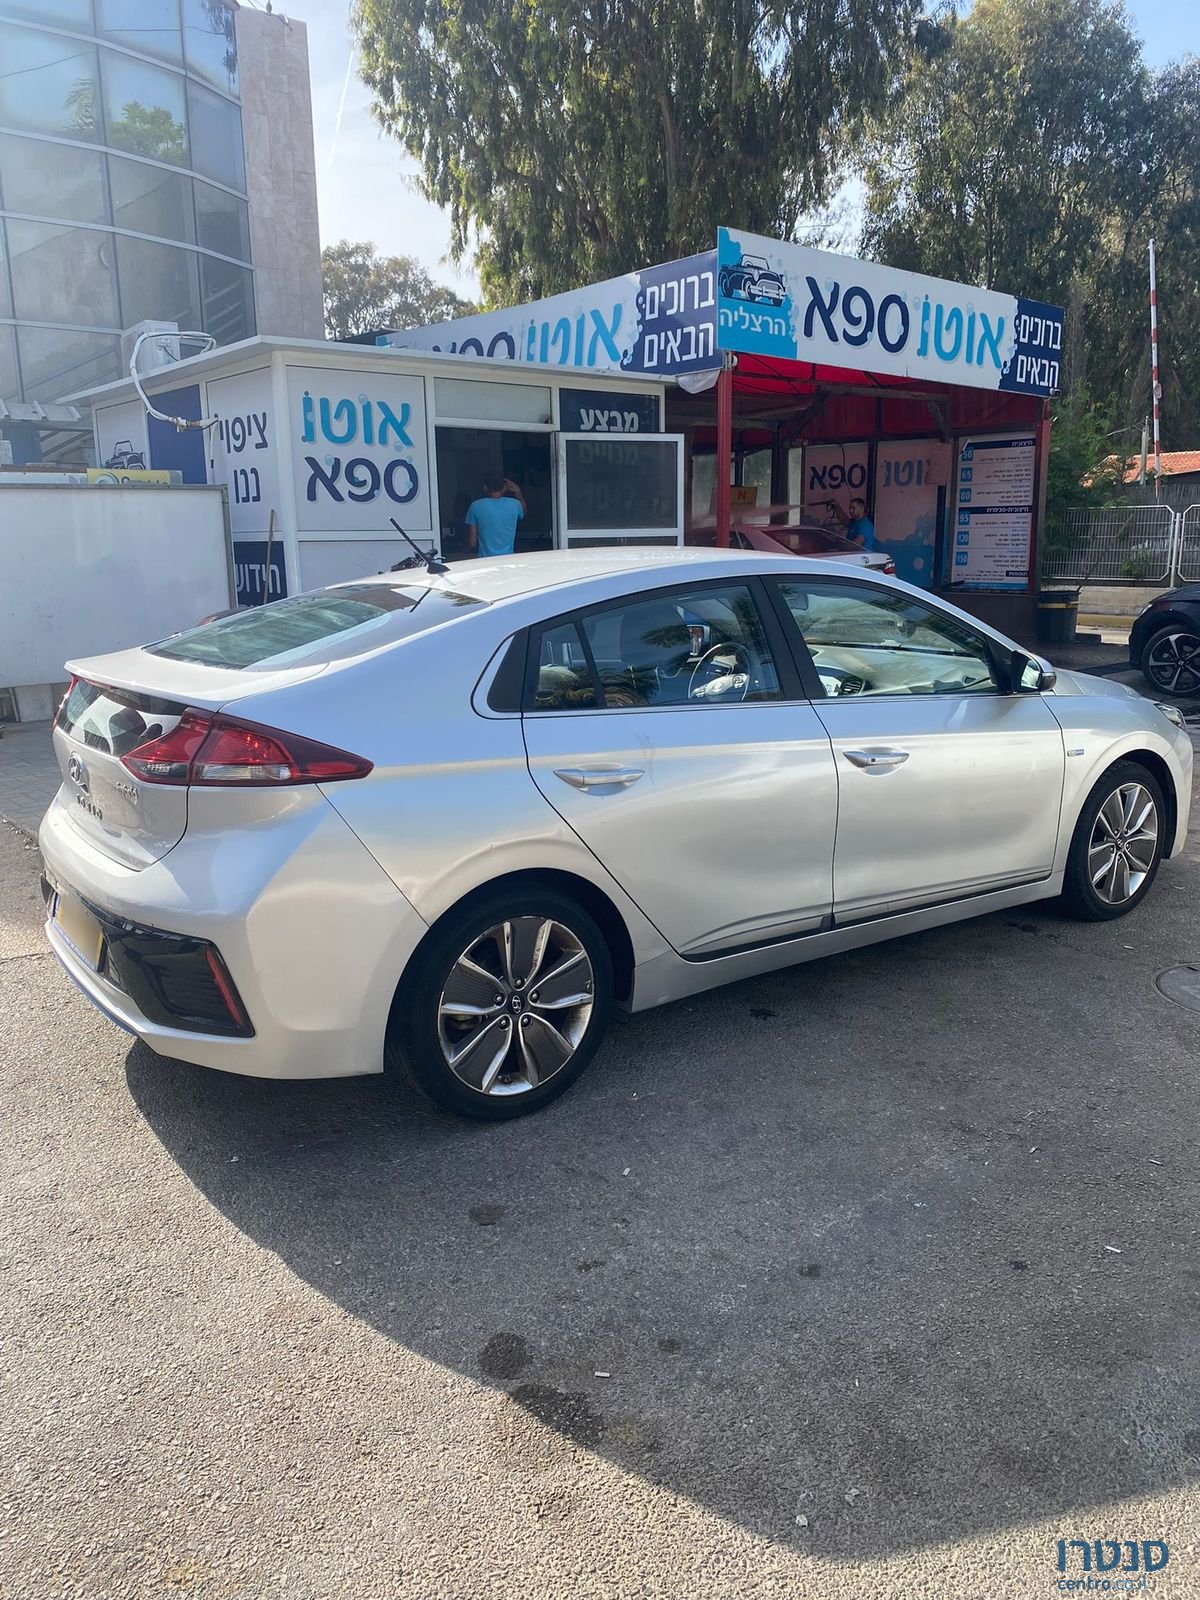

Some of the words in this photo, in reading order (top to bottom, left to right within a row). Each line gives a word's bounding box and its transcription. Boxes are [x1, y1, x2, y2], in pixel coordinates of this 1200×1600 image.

[644, 272, 715, 320] ברוכים
[720, 306, 786, 337] הרצליה
[803, 276, 910, 353] ספא
[1020, 314, 1062, 350] ברוכים
[644, 323, 714, 369] הבאים
[918, 298, 1005, 369] אוטו
[1016, 355, 1060, 389] הבאים
[220, 411, 268, 454] ציפוי
[302, 394, 413, 447] אוטו
[580, 408, 639, 432] מבצע
[962, 450, 972, 459] 50
[234, 466, 261, 504] ננו
[304, 456, 419, 504] ספא
[809, 463, 867, 490] ספא
[962, 470, 972, 479] 65
[961, 490, 970, 500] 80
[959, 514, 969, 522] 95
